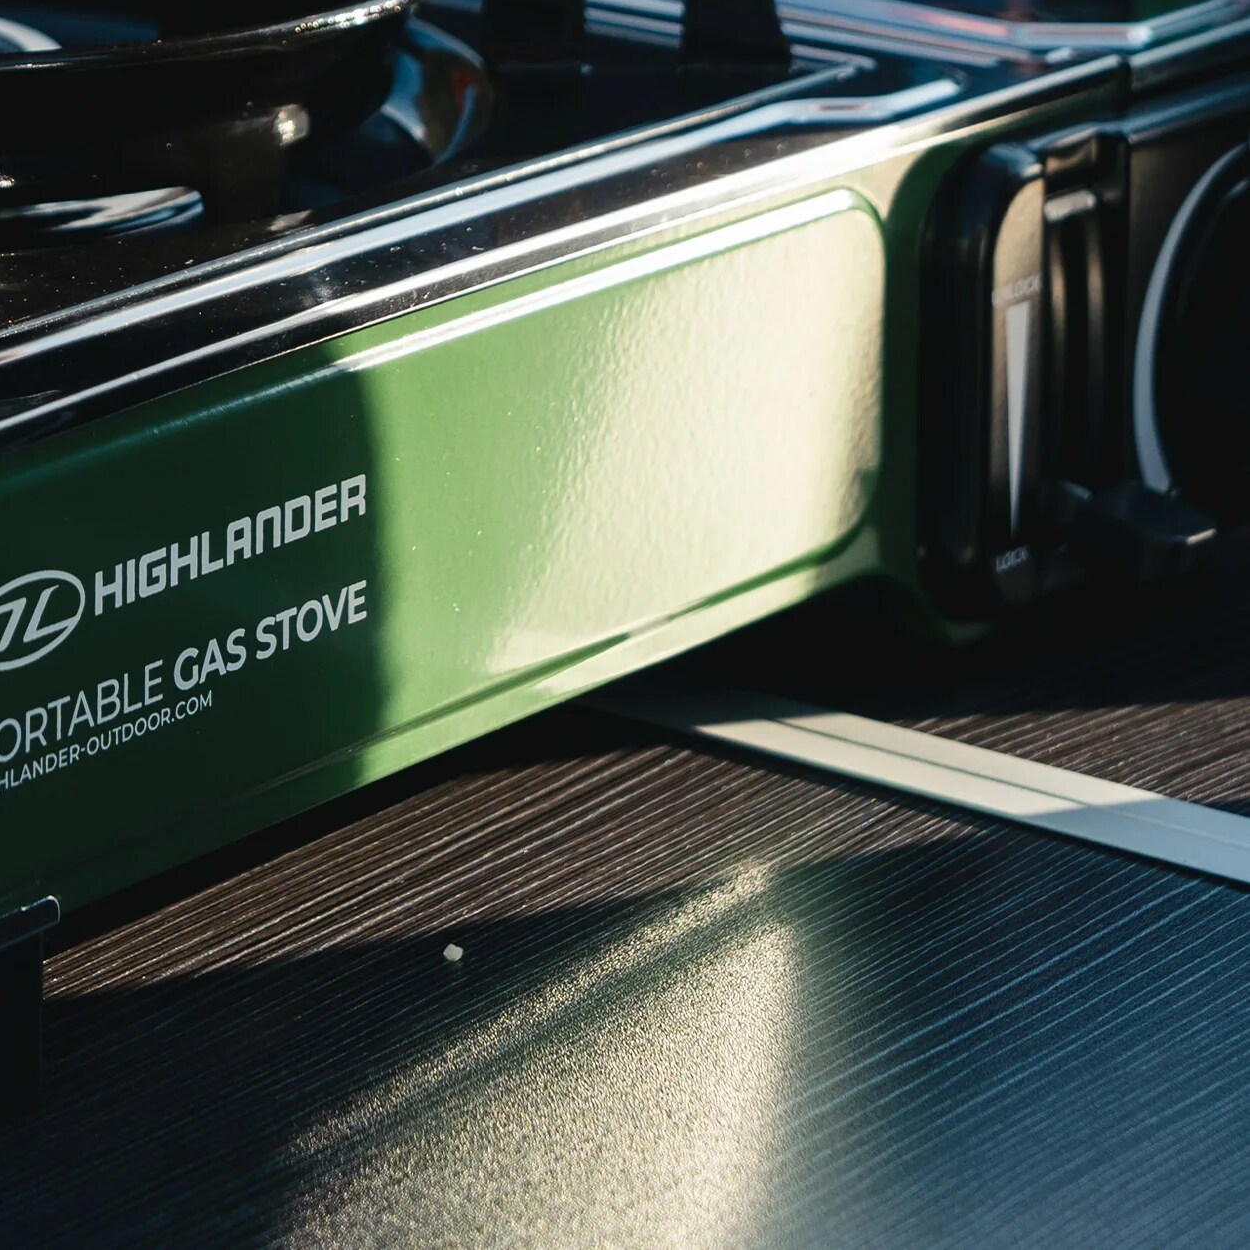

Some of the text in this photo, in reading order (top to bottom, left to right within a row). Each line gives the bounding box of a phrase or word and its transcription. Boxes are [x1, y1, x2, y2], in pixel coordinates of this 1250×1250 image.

[94, 473, 367, 616] HIGHLANDER
[173, 627, 247, 691] GAS
[256, 579, 368, 660] STOVE
